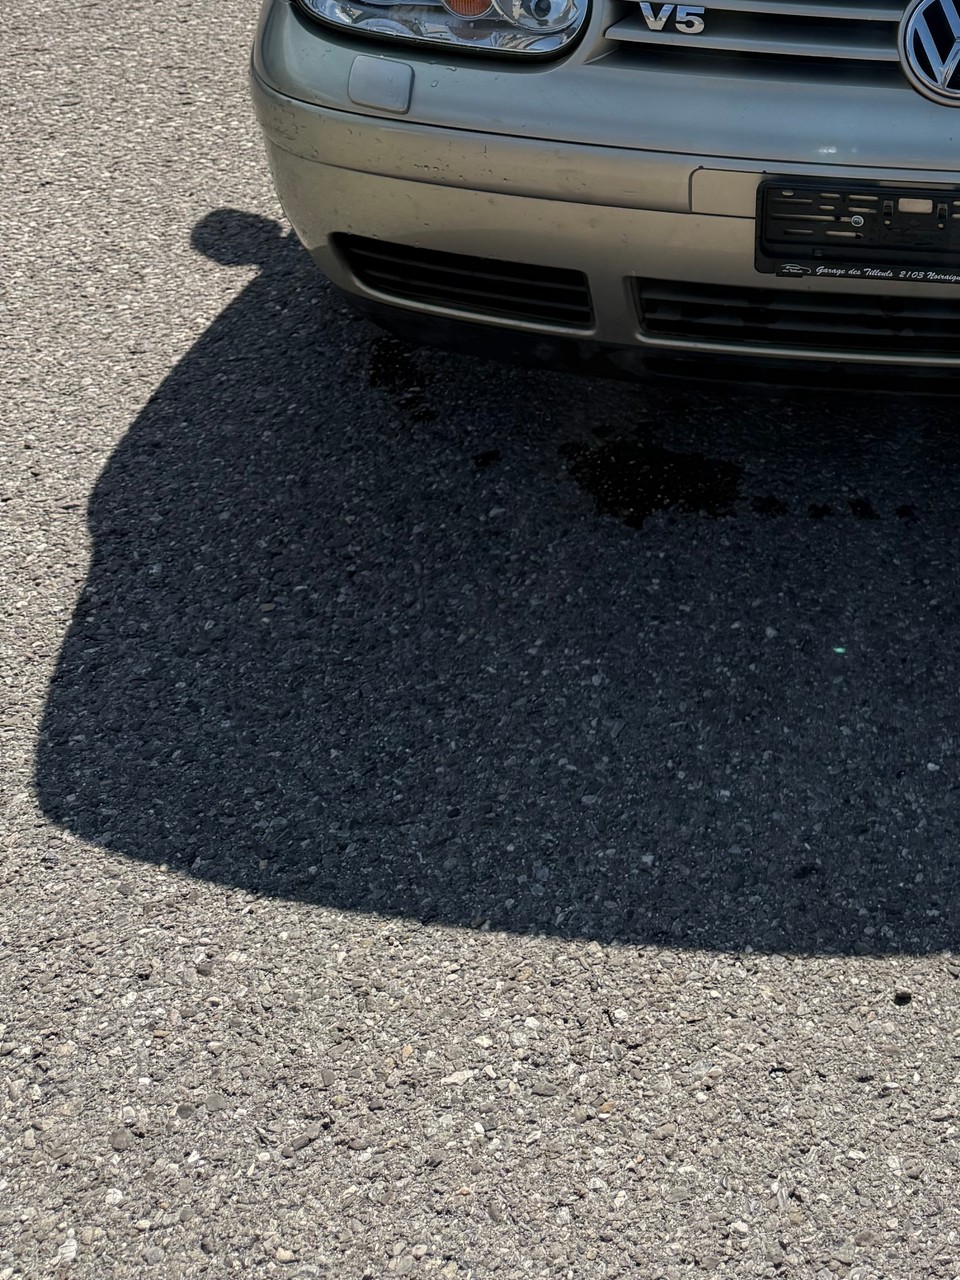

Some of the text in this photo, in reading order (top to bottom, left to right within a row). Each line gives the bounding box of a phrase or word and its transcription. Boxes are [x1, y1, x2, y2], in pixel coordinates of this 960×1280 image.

[639, 1, 705, 34] V5
[815, 266, 845, 276] Garage
[863, 268, 893, 277] Tilleuls
[899, 270, 924, 279] 2103
